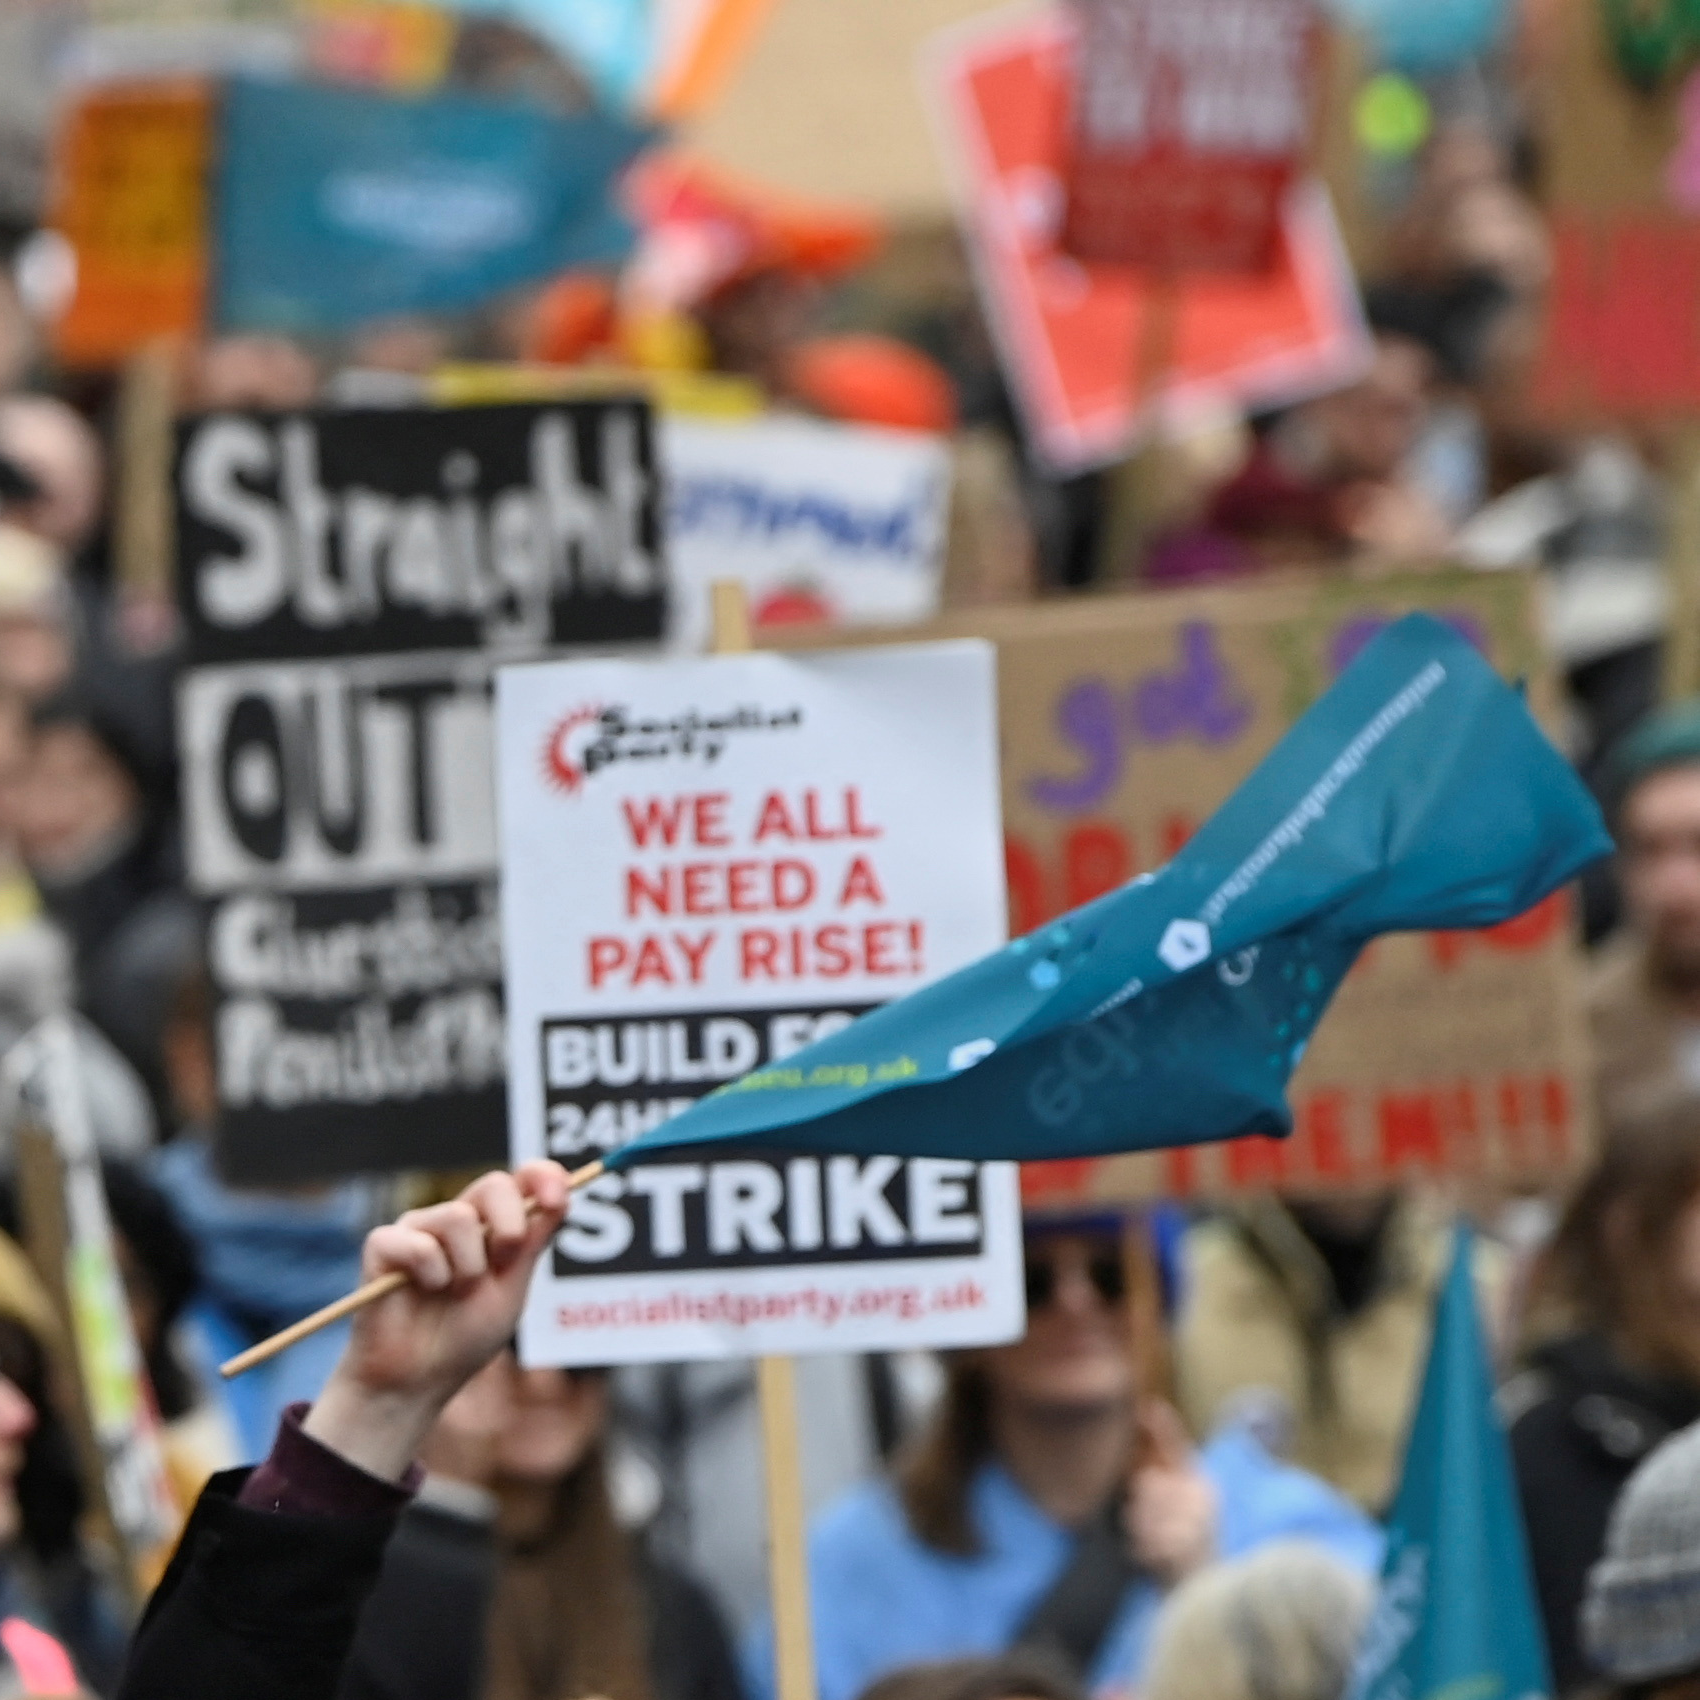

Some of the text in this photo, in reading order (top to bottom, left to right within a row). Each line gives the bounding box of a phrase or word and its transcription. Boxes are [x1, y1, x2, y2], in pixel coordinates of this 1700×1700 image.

[183, 414, 657, 652] Straight
[221, 690, 499, 862] OUT
[623, 788, 883, 848] WE ALL
[625, 852, 887, 918] NEED A
[585, 918, 925, 992] PAY RISE!
[547, 1015, 759, 1088] BUILD
[556, 1154, 983, 1264] STRIKE
[556, 1280, 987, 1334] socialistparty.org.uk
